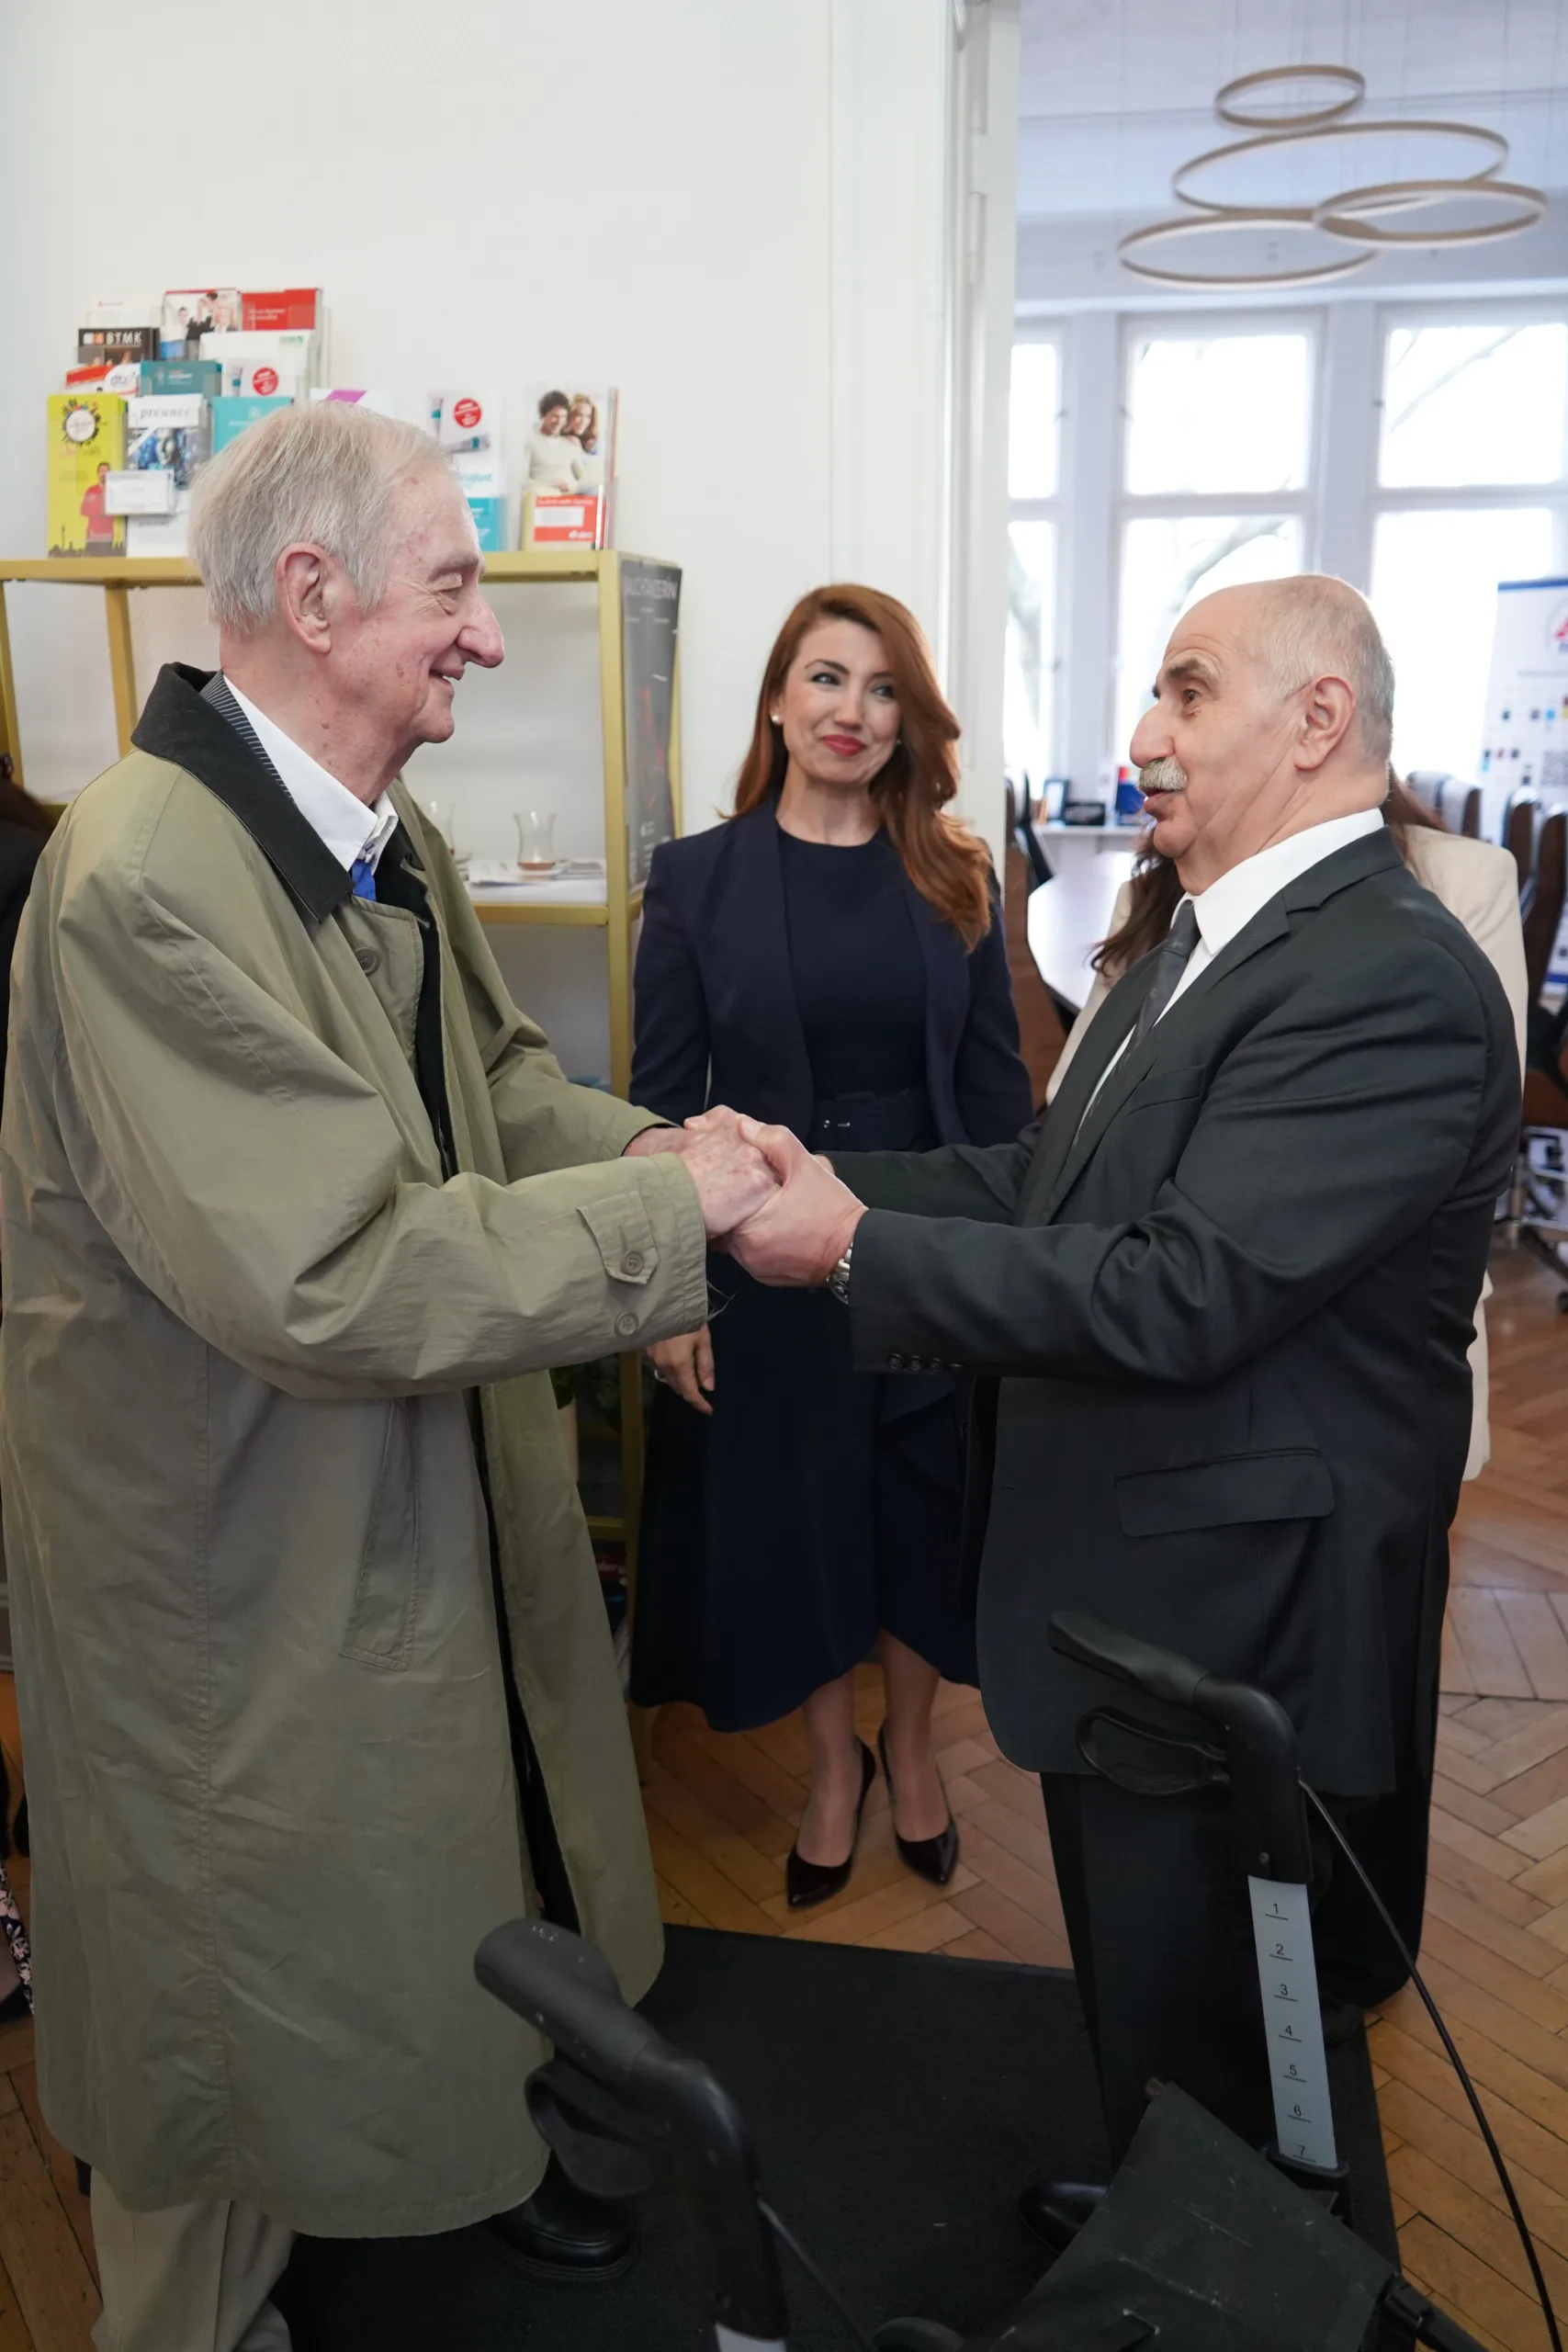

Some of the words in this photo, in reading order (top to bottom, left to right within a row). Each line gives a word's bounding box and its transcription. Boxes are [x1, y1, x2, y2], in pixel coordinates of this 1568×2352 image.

[1272, 1903, 1279, 1914] 1
[1276, 1943, 1284, 1956] 2
[1280, 1984, 1289, 1996] 3
[1285, 2025, 1292, 2036] 4
[1290, 2064, 1297, 2076] 5
[1294, 2105, 1302, 2117] 6
[1299, 2145, 1306, 2155] 7
